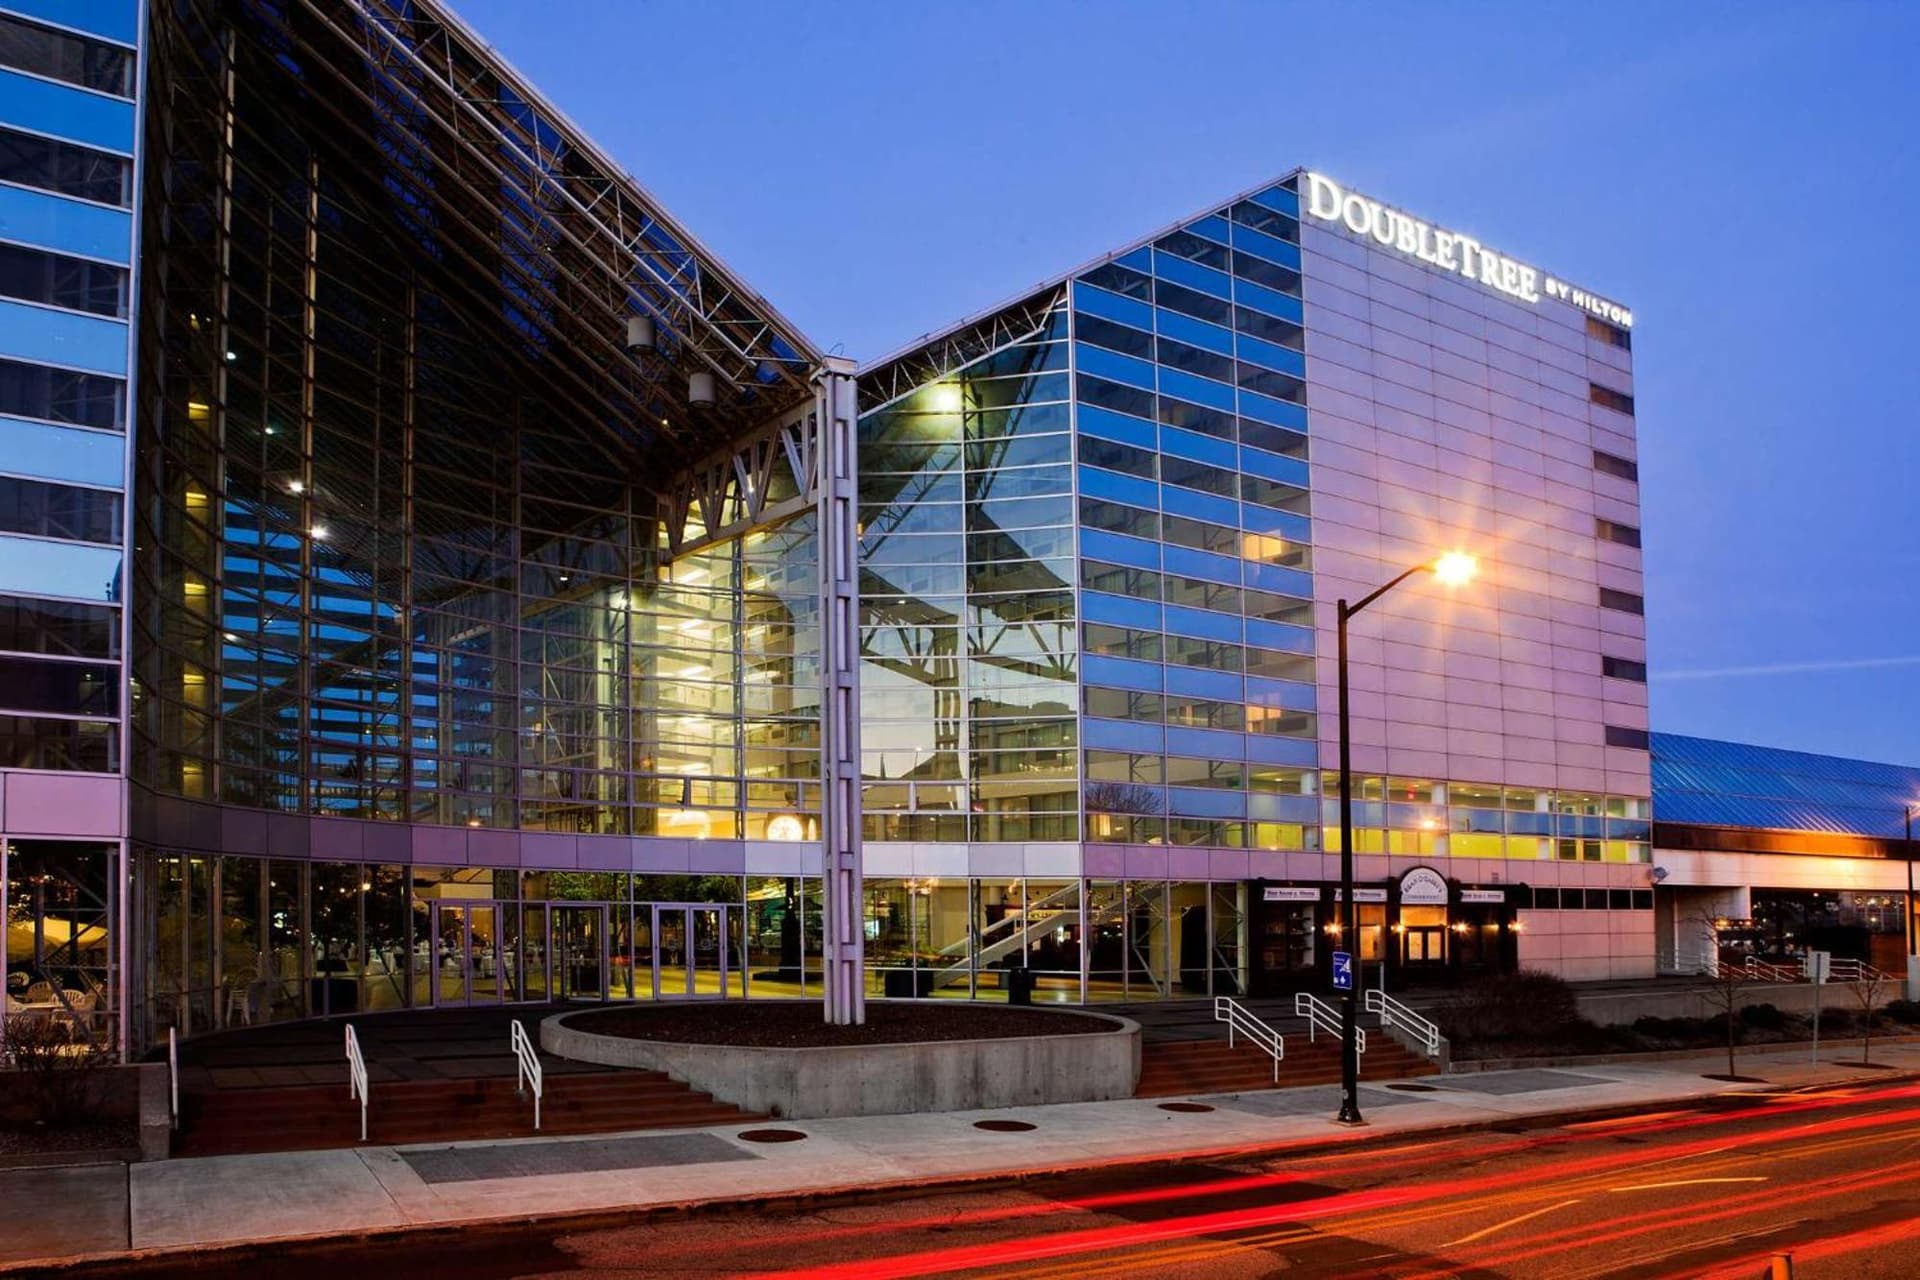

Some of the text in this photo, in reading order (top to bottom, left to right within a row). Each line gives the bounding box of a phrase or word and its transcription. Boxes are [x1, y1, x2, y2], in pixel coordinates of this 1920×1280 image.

[1307, 172, 1632, 327] DOUBLETREE BY HILTON
